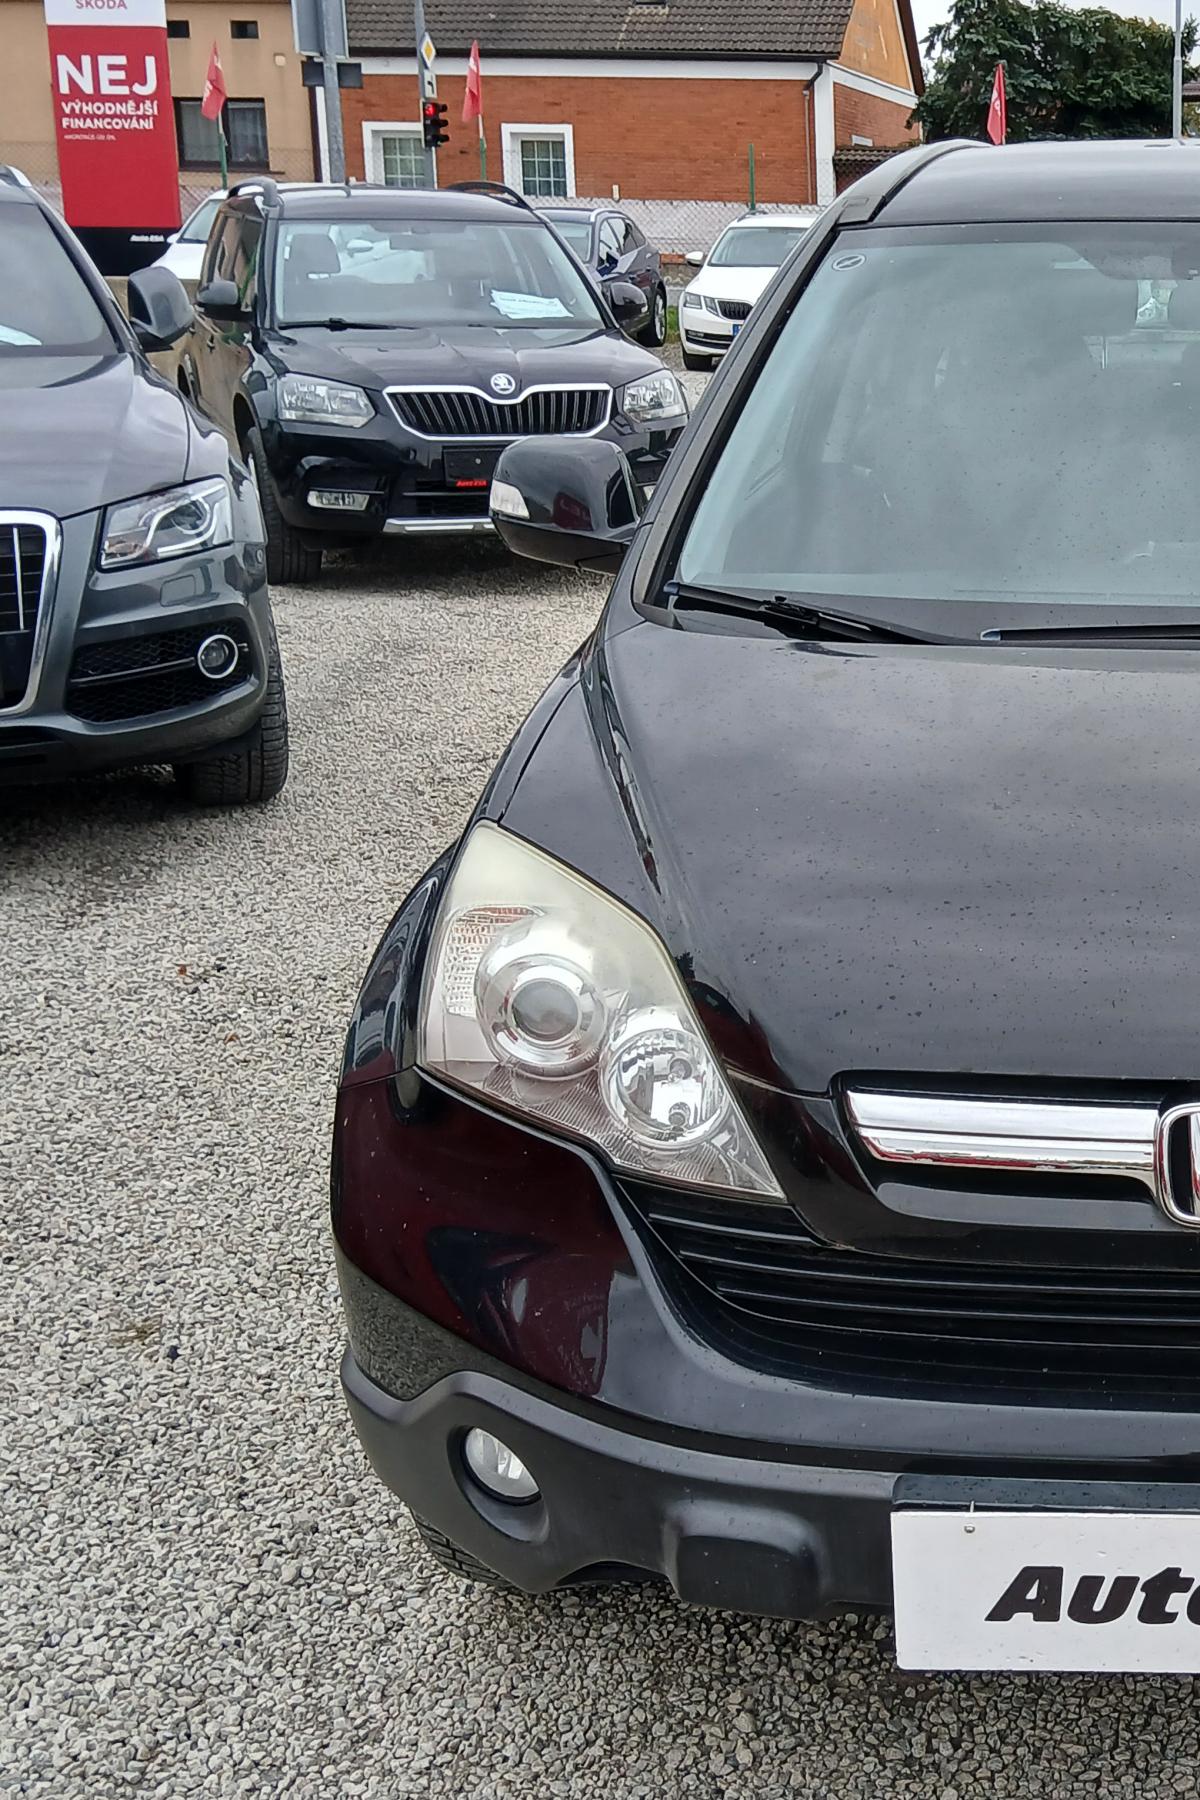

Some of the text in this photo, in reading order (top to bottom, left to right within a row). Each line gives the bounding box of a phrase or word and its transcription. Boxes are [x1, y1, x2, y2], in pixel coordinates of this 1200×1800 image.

[56, 54, 157, 96] NEJ
[61, 99, 158, 116] VÝHODNĚJŠÍ
[62, 117, 154, 130] FINANCOVÁNÍ
